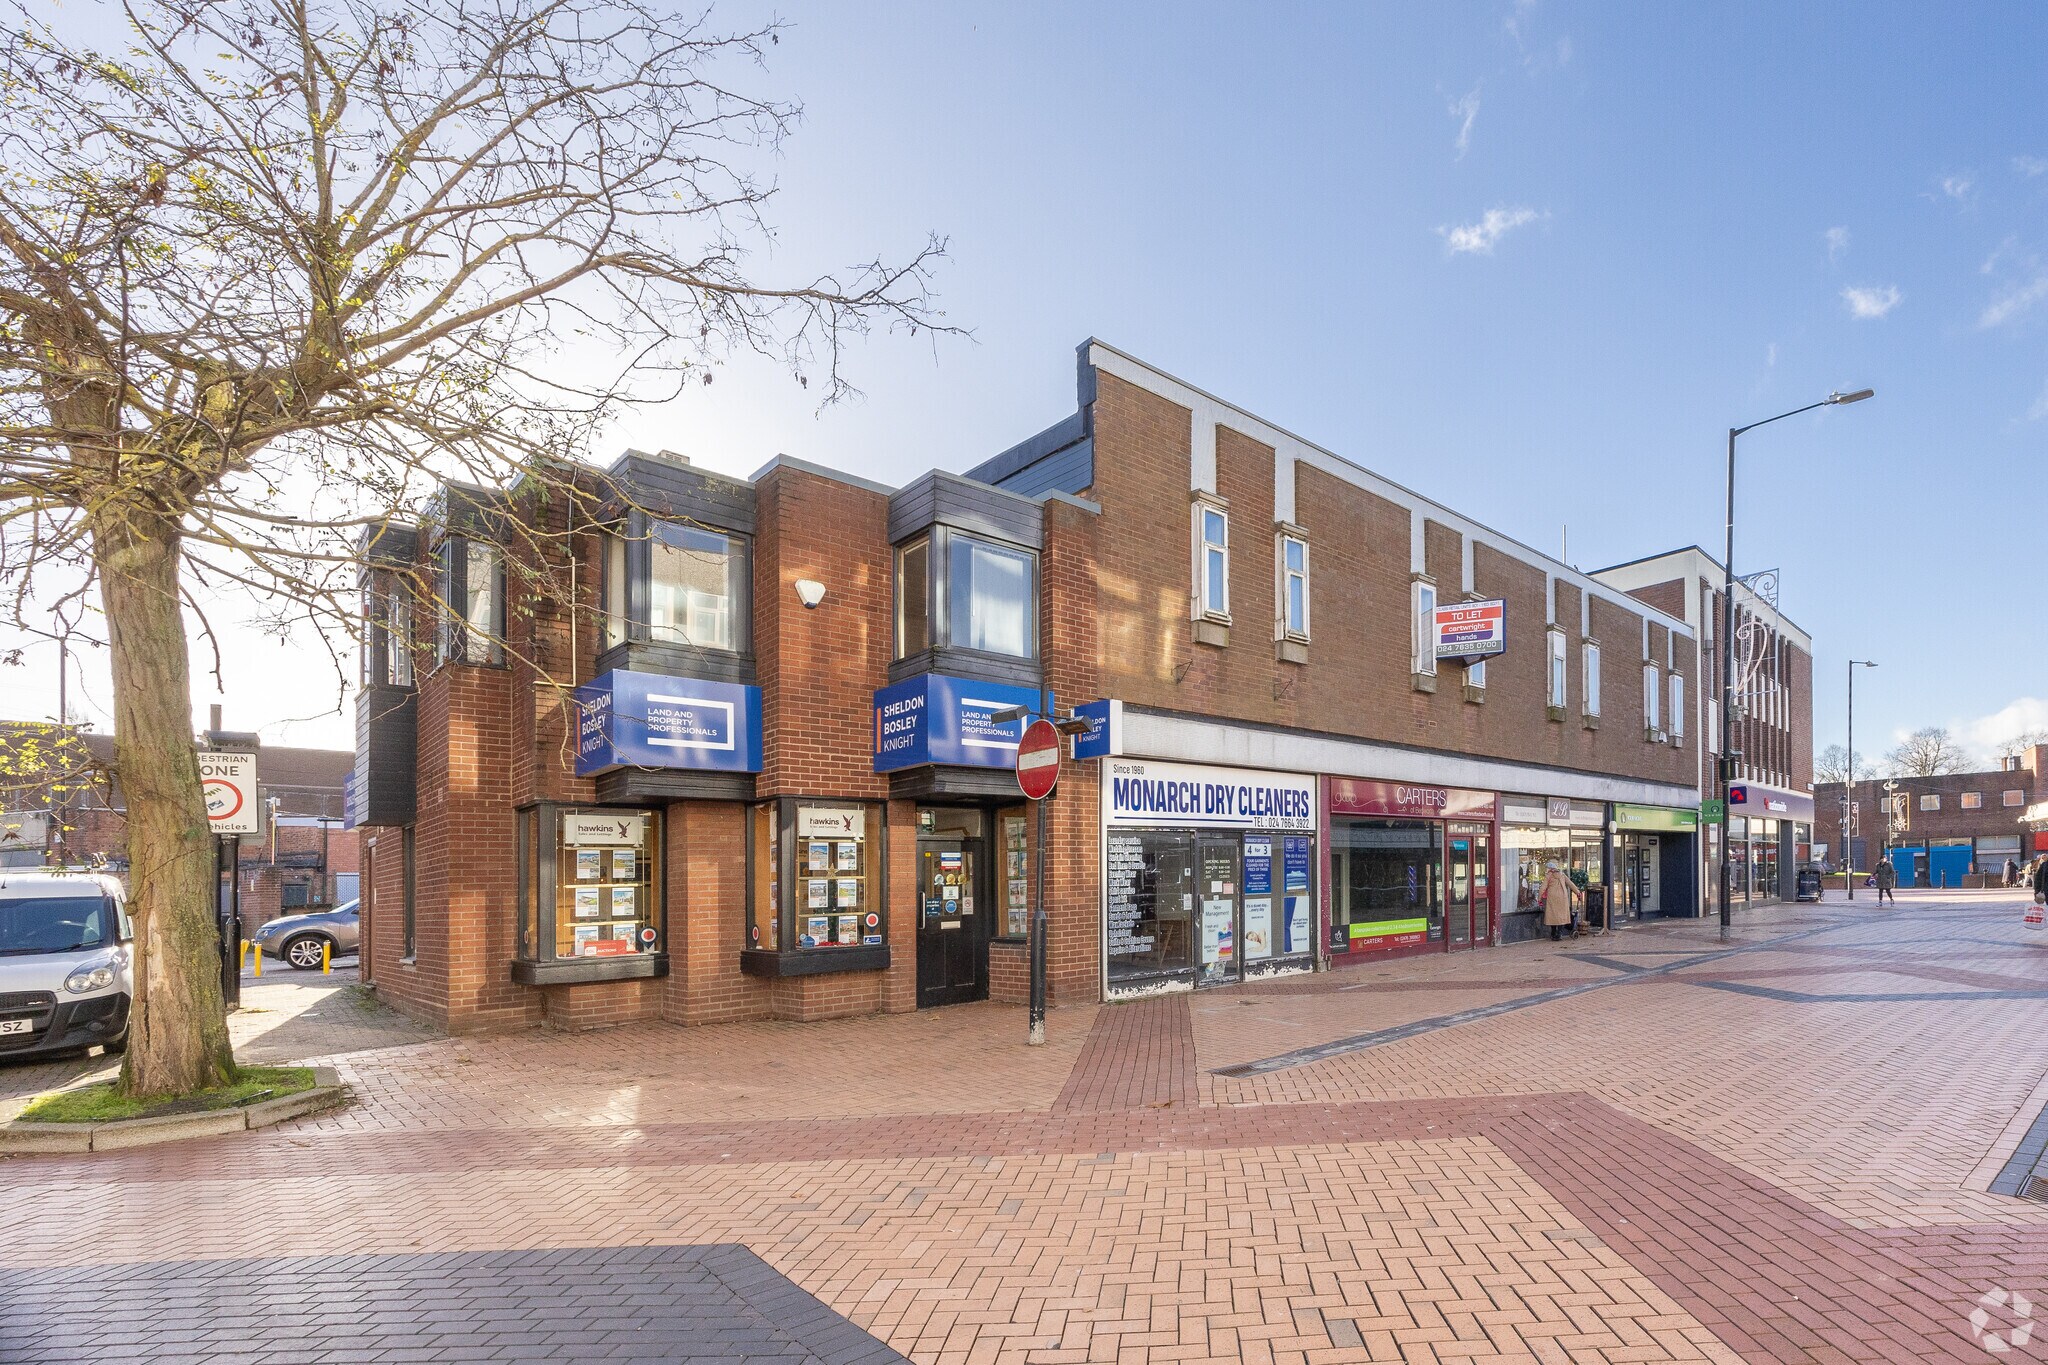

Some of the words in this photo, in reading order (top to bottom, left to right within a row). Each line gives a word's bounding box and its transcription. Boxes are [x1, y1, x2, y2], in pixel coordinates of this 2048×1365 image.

[1451, 612, 1464, 620] TO
[1466, 610, 1482, 619] LET
[1449, 624, 1486, 632] cartwright
[582, 692, 612, 718] SHELDON
[884, 695, 924, 718] SHELDON
[647, 707, 673, 717] LAND
[674, 709, 694, 719] AND
[961, 710, 980, 719] LAND
[980, 712, 992, 720] AN
[582, 714, 607, 736] BOSLEY
[647, 716, 694, 726] PROPERTY
[884, 714, 918, 736] BOSLEY
[647, 724, 718, 737] PROFESSIONALS
[961, 724, 1015, 738] PROFESSIONALS
[884, 733, 915, 752] KNIGHT
[1082, 734, 1101, 742] KNIGHT
[582, 733, 605, 755] KNIGHT
[201, 765, 240, 776] ONE
[1113, 764, 1130, 774] Since
[1131, 765, 1144, 775] 1960
[1113, 777, 1200, 814] MONARCH
[1205, 783, 1236, 815] DRY
[1238, 785, 1309, 818] CLEANERS
[1396, 786, 1446, 807] CARTERS
[809, 817, 840, 826] hawkins
[1268, 818, 1280, 828] 024
[1281, 818, 1295, 828] 7664
[1296, 818, 1310, 829] 3922
[578, 824, 614, 833] hawkins
[1248, 845, 1252, 854] 4
[1264, 845, 1268, 854] 3
[0, 1021, 23, 1032] SZ
